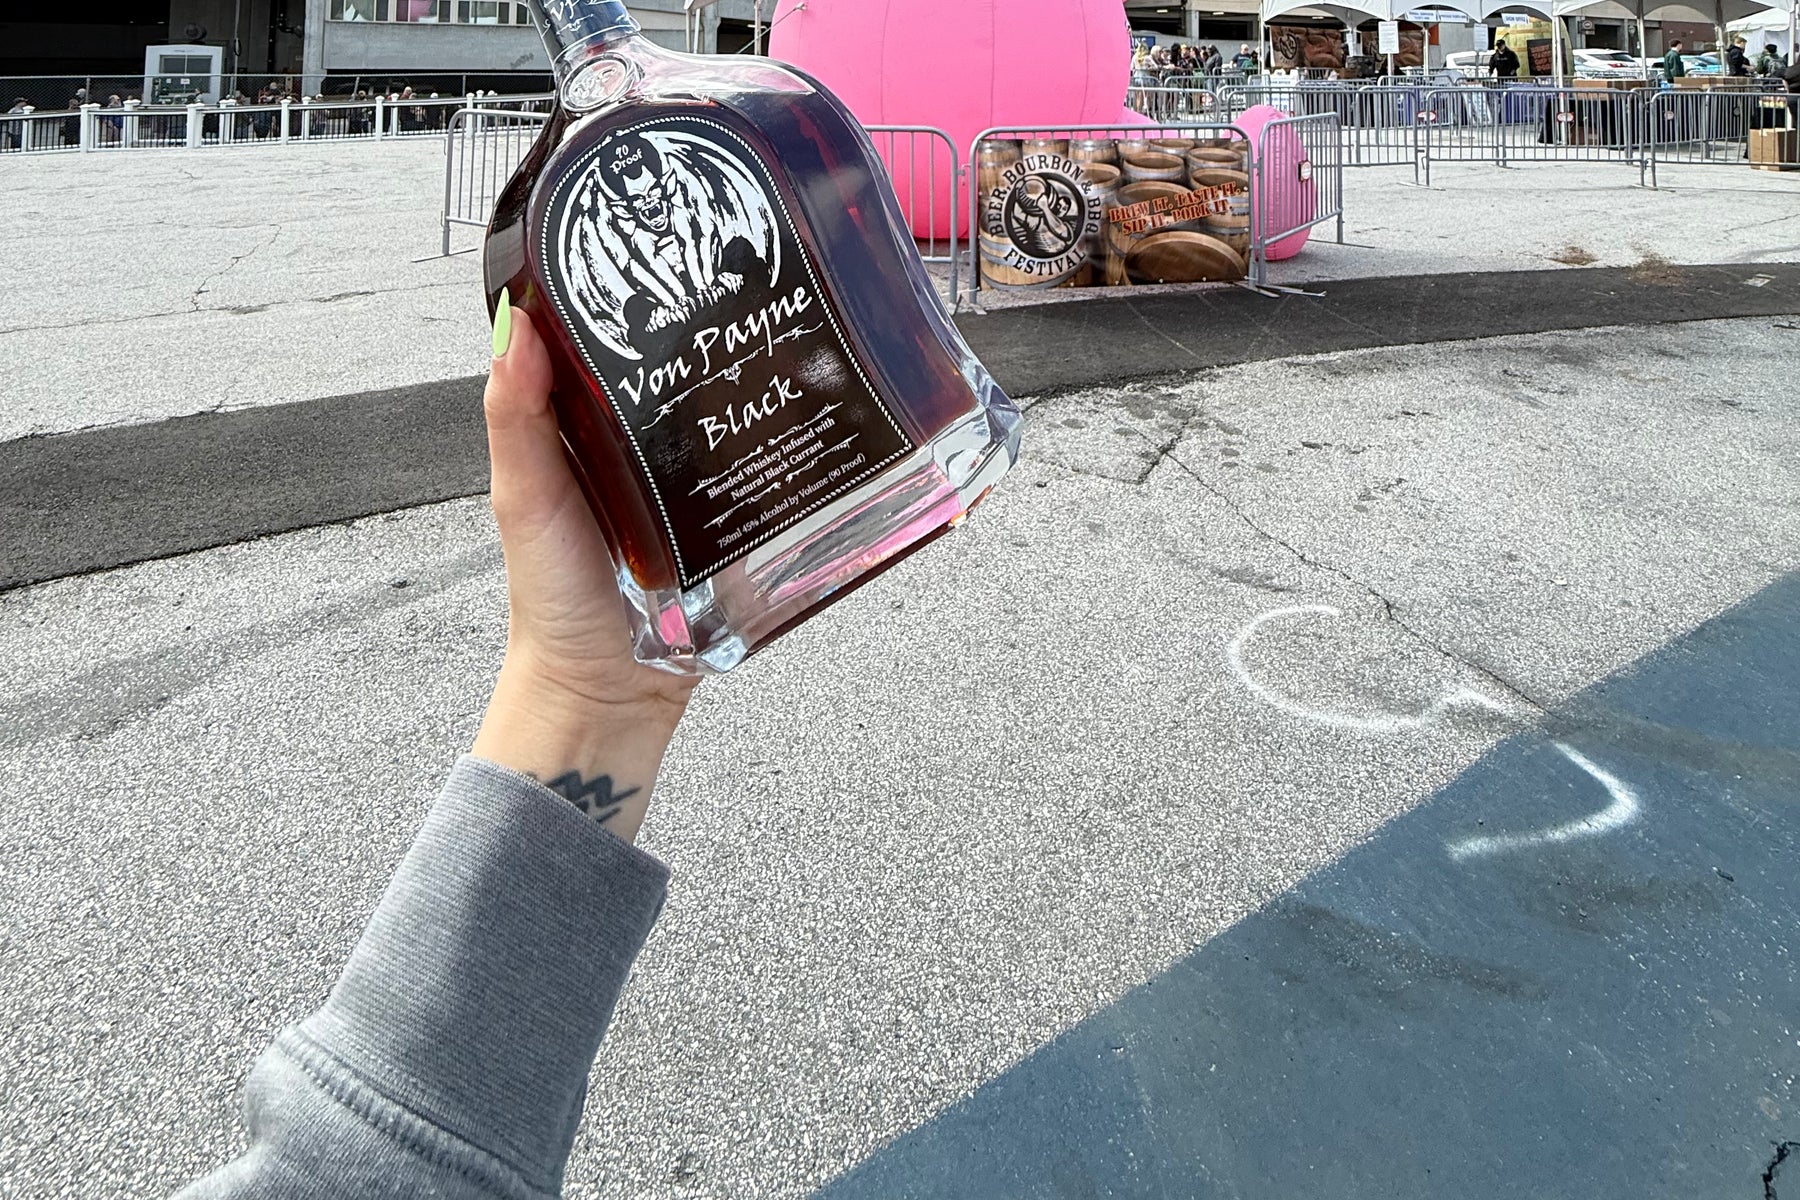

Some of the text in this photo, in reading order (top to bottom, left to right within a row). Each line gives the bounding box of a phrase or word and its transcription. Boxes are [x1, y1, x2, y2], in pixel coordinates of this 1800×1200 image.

[609, 148, 643, 175] Proof
[615, 144, 629, 159] 90
[988, 154, 1101, 237] BEER, BOURBON & BBQ
[1109, 181, 1241, 222] BREW IT. TASTE IT.
[1122, 199, 1233, 234] SIP IT. PORK IT.
[1003, 247, 1087, 276] FESTIVAL
[618, 286, 812, 406] Von Payne
[698, 375, 803, 451] Black
[706, 416, 836, 500] Blended Whiskey Infused with
[731, 440, 825, 501] Natural Black Currant
[717, 453, 866, 549] 750ml 45% Alcohol by Volume (90 Proof)
